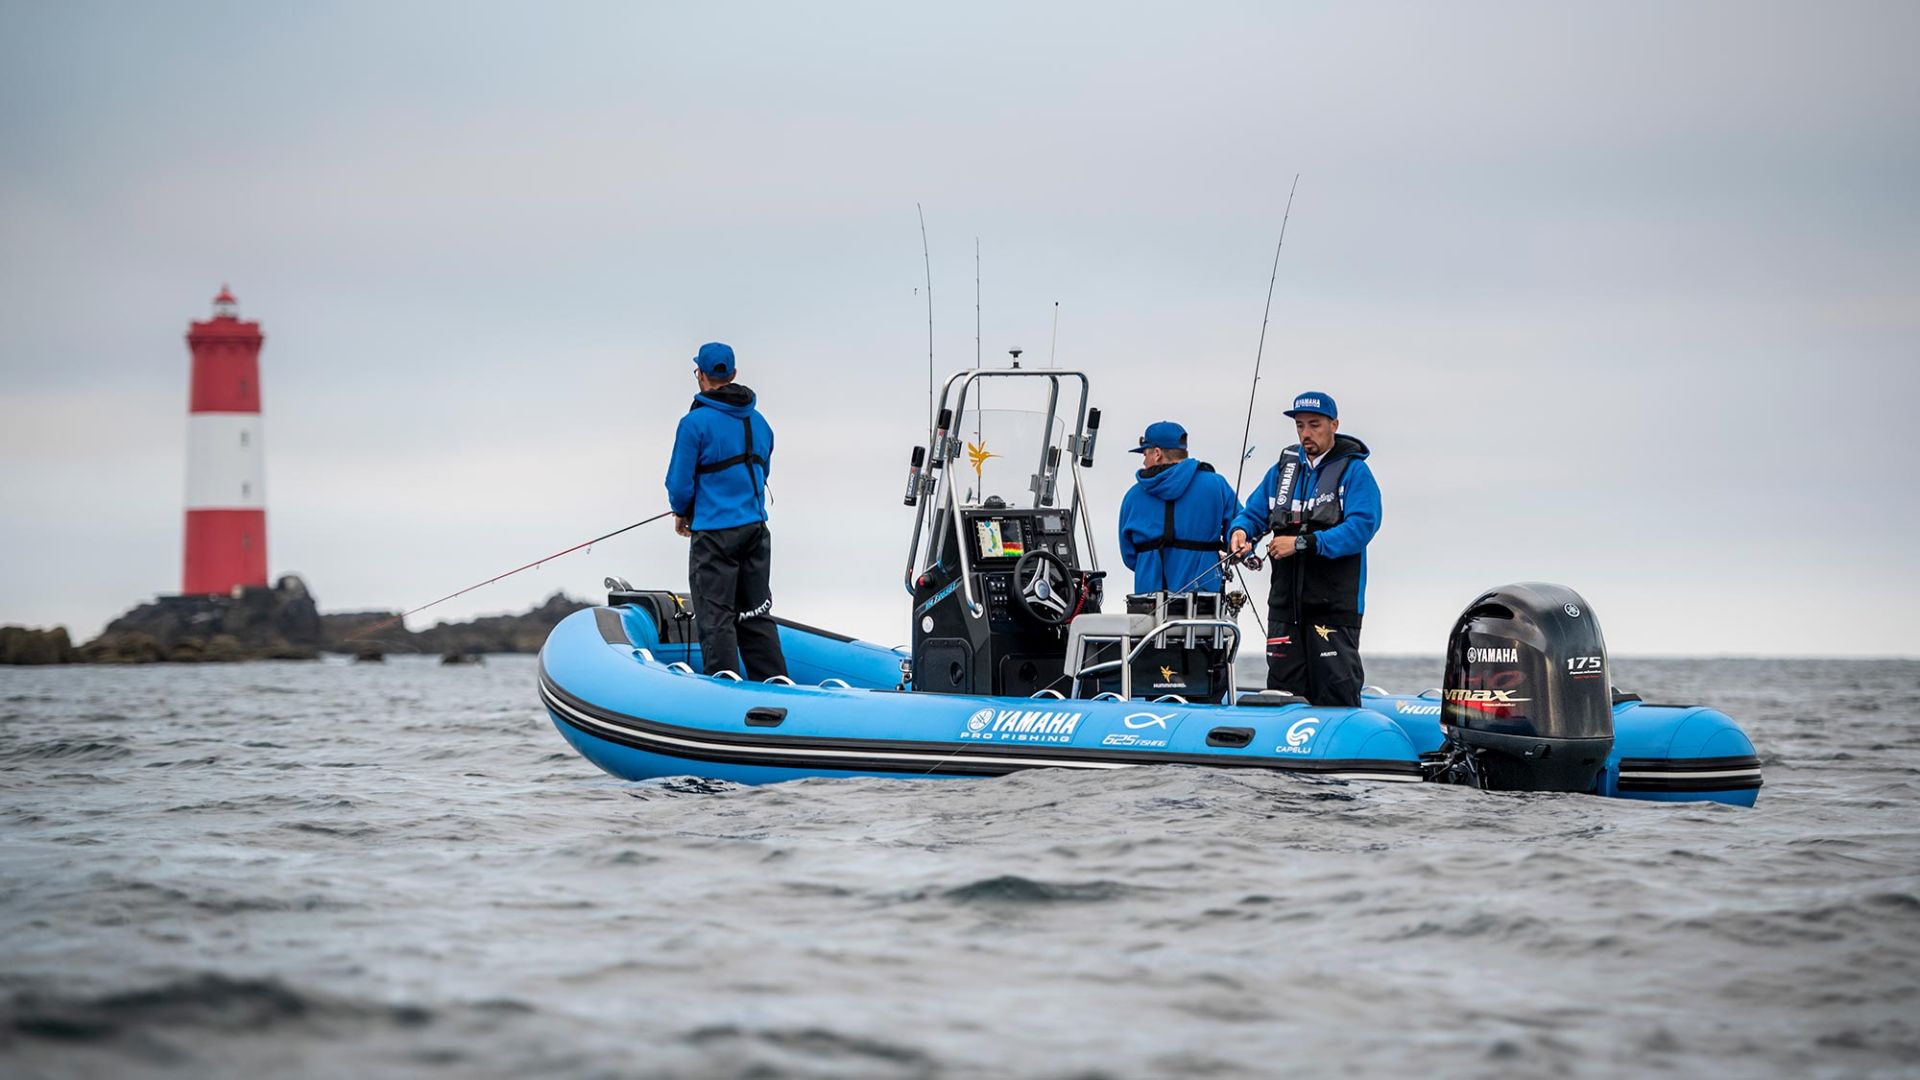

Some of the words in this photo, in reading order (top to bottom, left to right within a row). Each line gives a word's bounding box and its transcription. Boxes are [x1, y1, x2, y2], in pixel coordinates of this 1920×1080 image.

[1280, 462, 1297, 494] YAMAHA
[1477, 648, 1519, 663] YAMAHA
[1567, 656, 1602, 670] 175
[992, 710, 1082, 734] YAMAHA
[960, 732, 993, 740] PRO
[1001, 733, 1071, 743] FISHING
[1102, 734, 1139, 745] 625
[1275, 746, 1311, 754] CAPELLI
